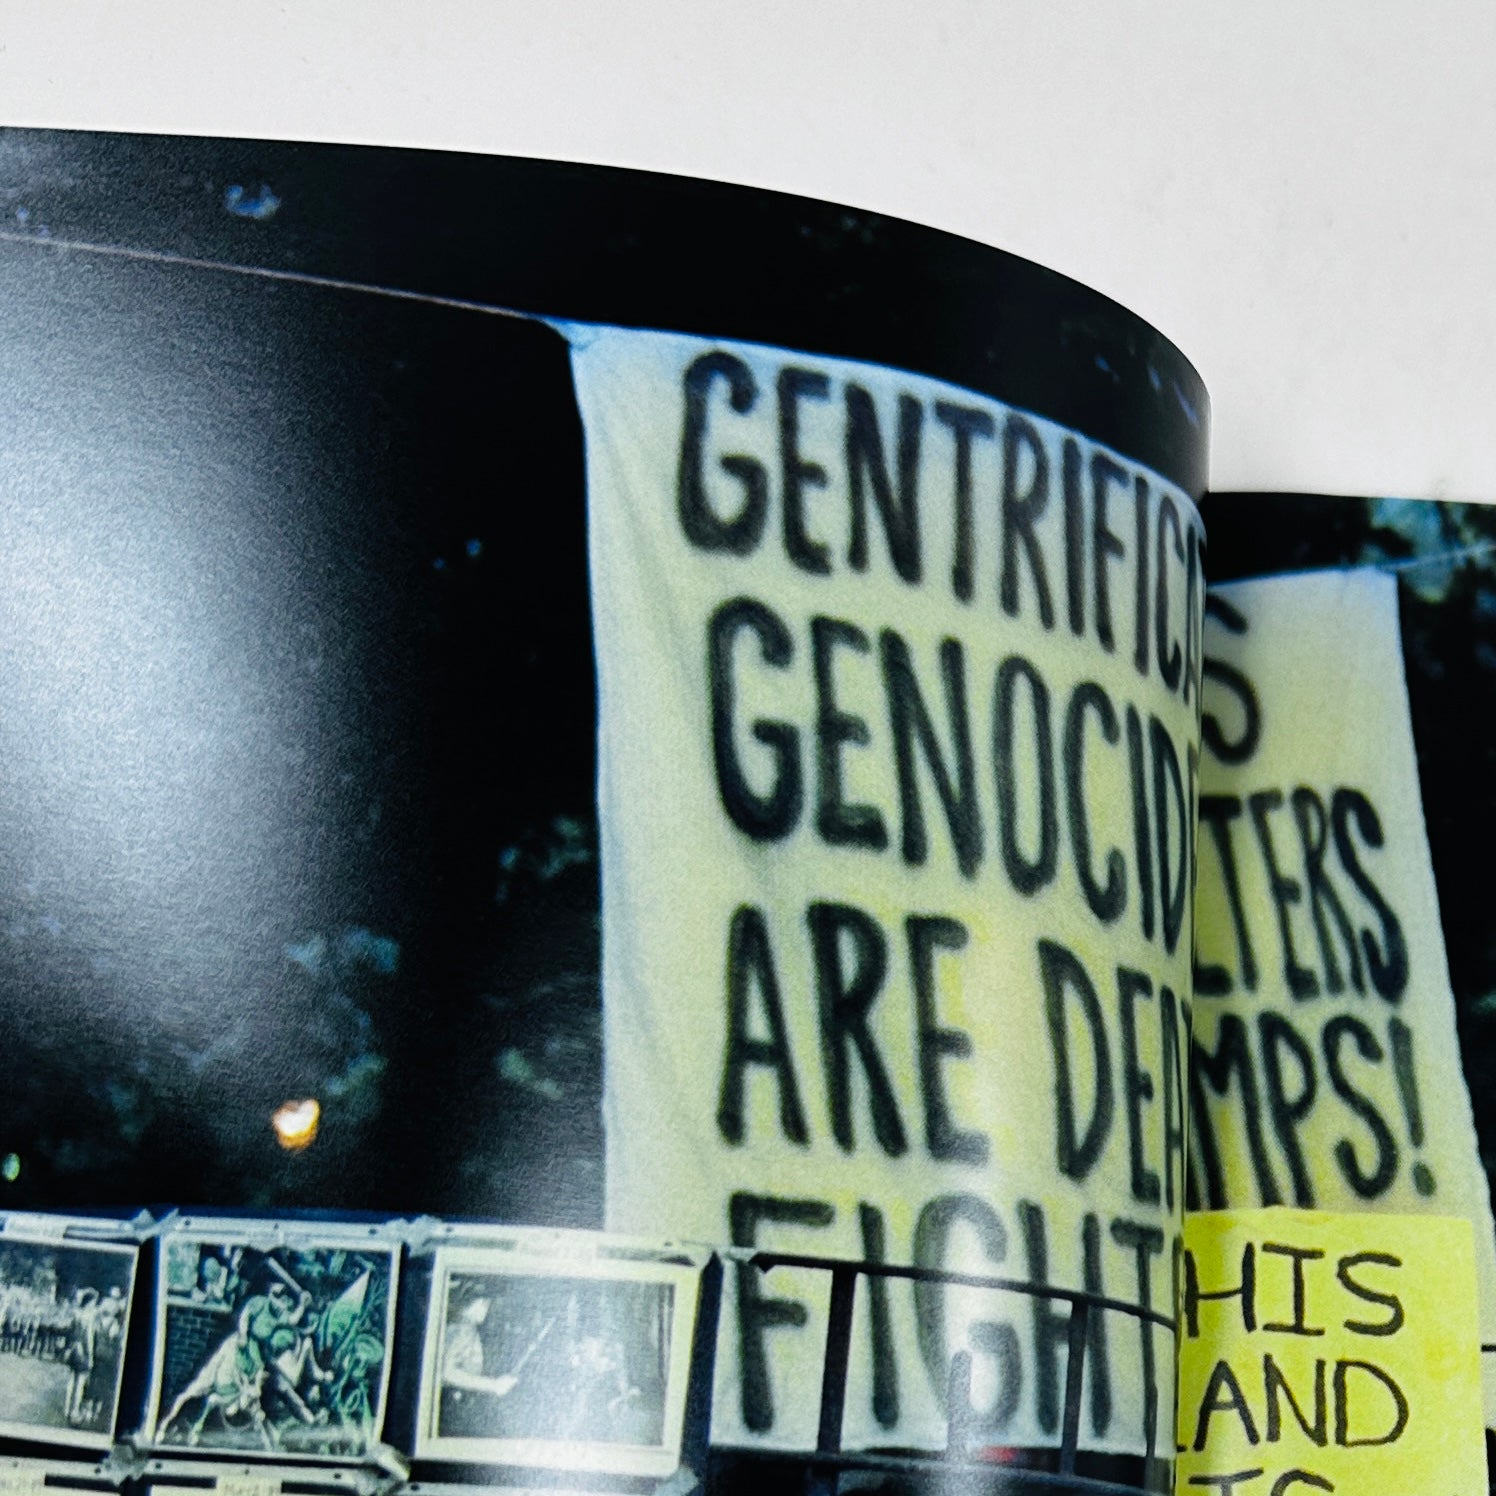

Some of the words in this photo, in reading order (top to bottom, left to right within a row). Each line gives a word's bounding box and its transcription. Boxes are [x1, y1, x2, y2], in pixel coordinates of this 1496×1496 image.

[676, 348, 1206, 708] GENTRIFICA
[1193, 784, 1409, 1004] TERS
[716, 901, 991, 1166] ARE
[1037, 936, 1193, 1218] DEA
[1187, 1010, 1438, 1209] MPS!
[729, 1190, 1166, 1446] FIGHT
[1177, 1352, 1410, 1452] AND
